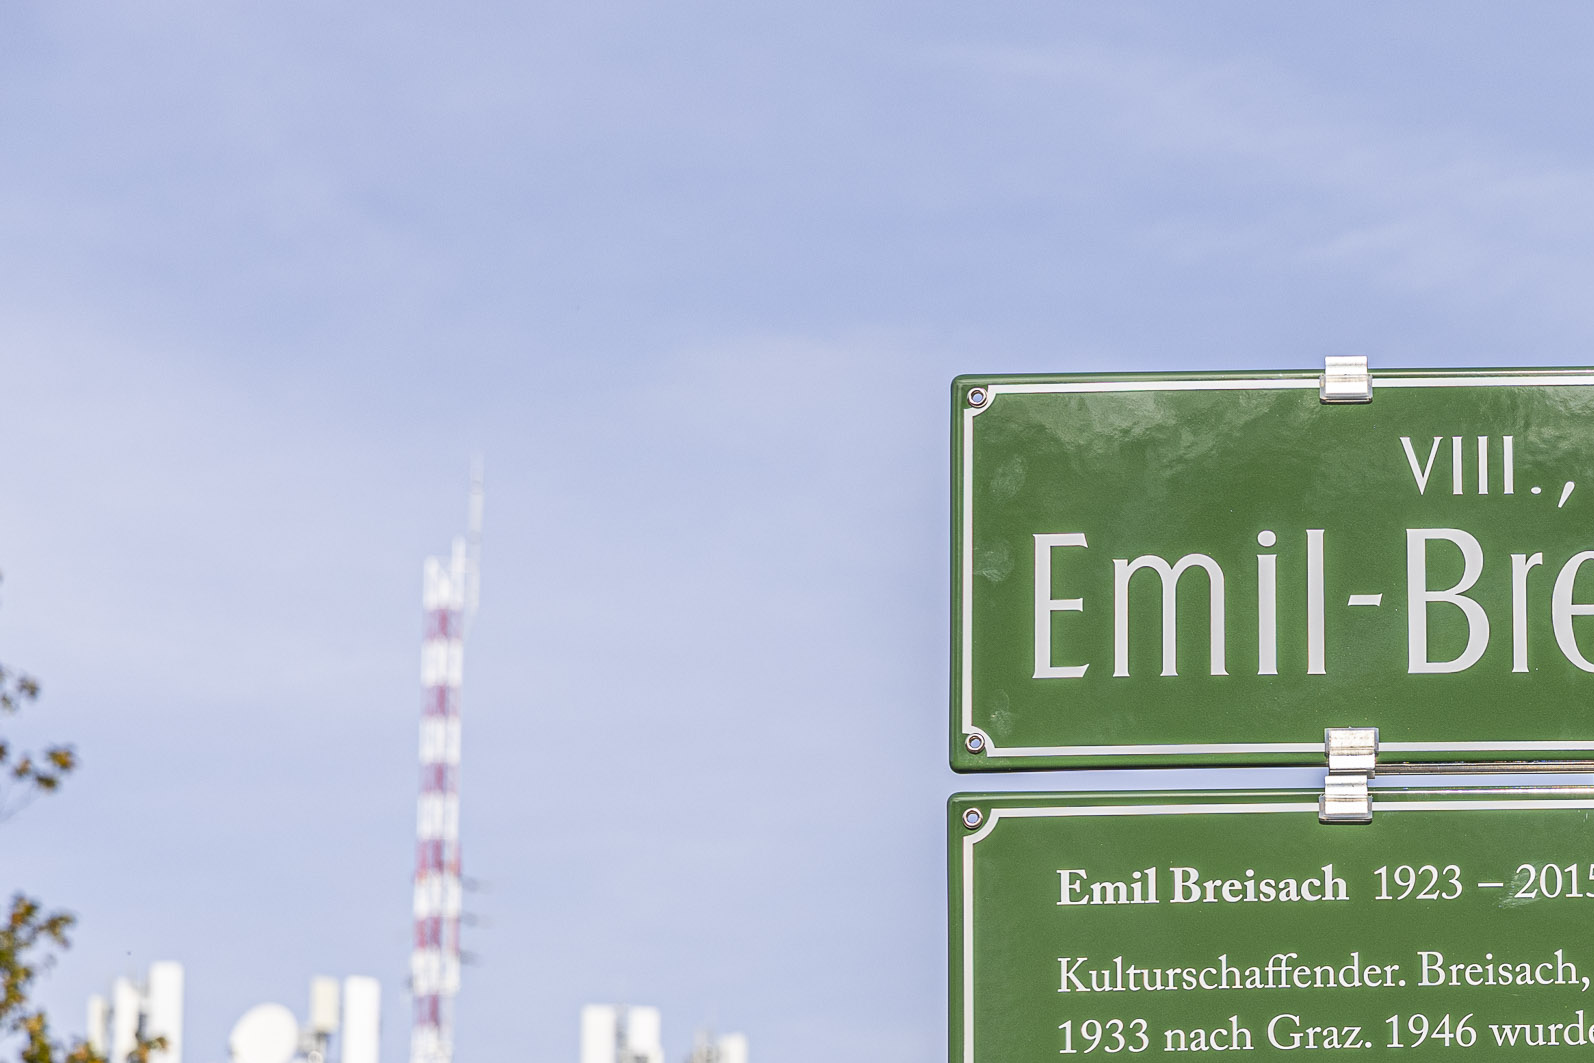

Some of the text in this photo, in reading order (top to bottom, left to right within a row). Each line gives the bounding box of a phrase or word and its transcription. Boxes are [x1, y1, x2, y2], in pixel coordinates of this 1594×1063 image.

[1399, 435, 1576, 509] VIII.,
[1055, 866, 1160, 906] Emil
[1169, 863, 1350, 903] Breisach
[1373, 864, 1463, 901] 1923
[1057, 951, 1406, 993] Kulturschaffender.
[1416, 948, 1590, 992] Breisach,
[1058, 1018, 1150, 1054] 1933
[1163, 1014, 1255, 1052] nach
[1267, 1013, 1373, 1050] Graz.
[1385, 1013, 1477, 1048] 1946
